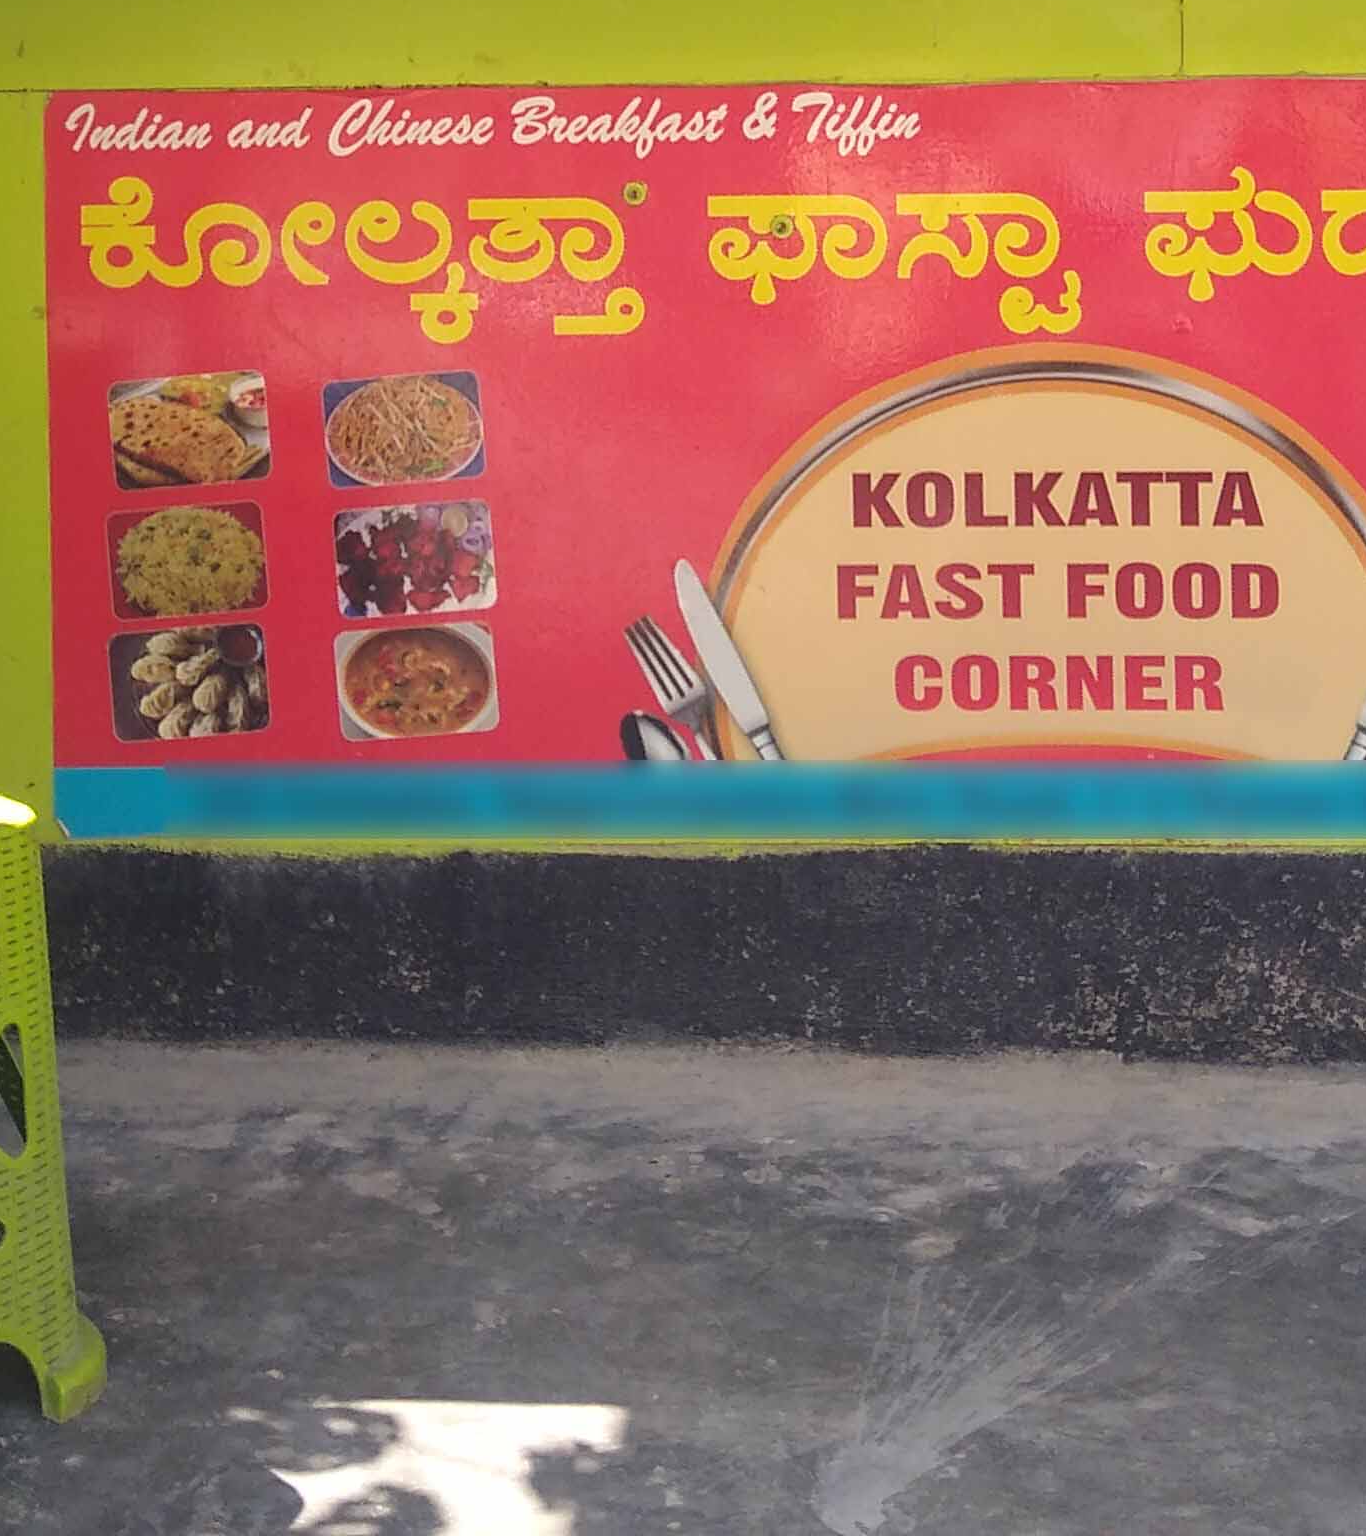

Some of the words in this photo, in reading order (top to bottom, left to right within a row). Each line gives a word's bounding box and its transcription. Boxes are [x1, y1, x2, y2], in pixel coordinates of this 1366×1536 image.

[64, 102, 212, 152] Indian
[227, 106, 313, 149] and
[327, 98, 495, 157] Chinese
[510, 95, 728, 160] Breakfast
[741, 91, 779, 141] &
[790, 91, 922, 158] Tiffin
[851, 470, 1263, 529] KOLKATTA
[836, 562, 1035, 620] FAST
[1066, 561, 1281, 620] FOOD
[893, 654, 1224, 712] CORNER
